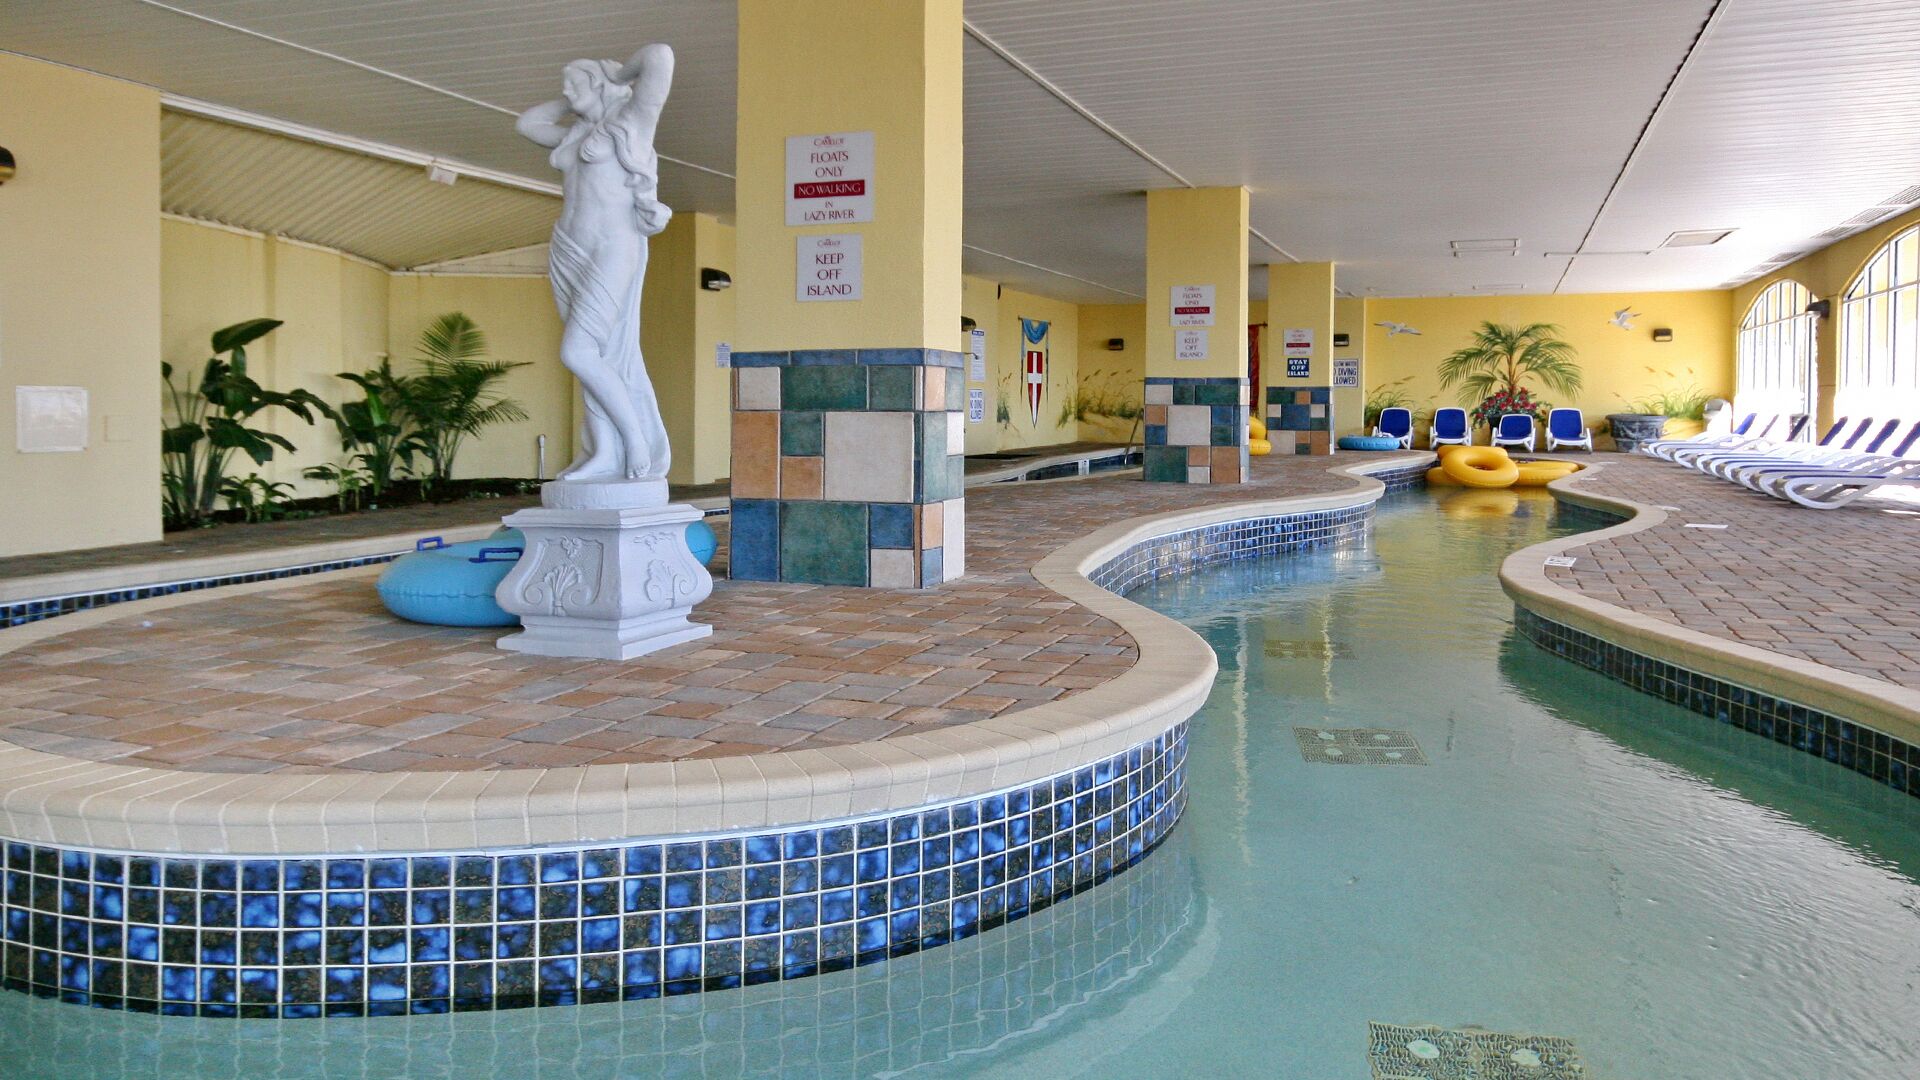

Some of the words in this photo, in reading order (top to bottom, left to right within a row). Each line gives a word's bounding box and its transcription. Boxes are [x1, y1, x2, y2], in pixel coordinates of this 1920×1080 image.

[810, 150, 850, 164] FLOATS
[815, 166, 845, 178] ONLY
[799, 185, 816, 196] NO
[816, 182, 861, 195] WALKING
[824, 201, 833, 209] IN
[804, 210, 827, 221] LAZY
[828, 208, 855, 220] RIVER
[815, 253, 844, 265] KEEP
[817, 268, 843, 281] OFF
[807, 283, 852, 296] ISLAND
[1338, 367, 1357, 376] DIVING
